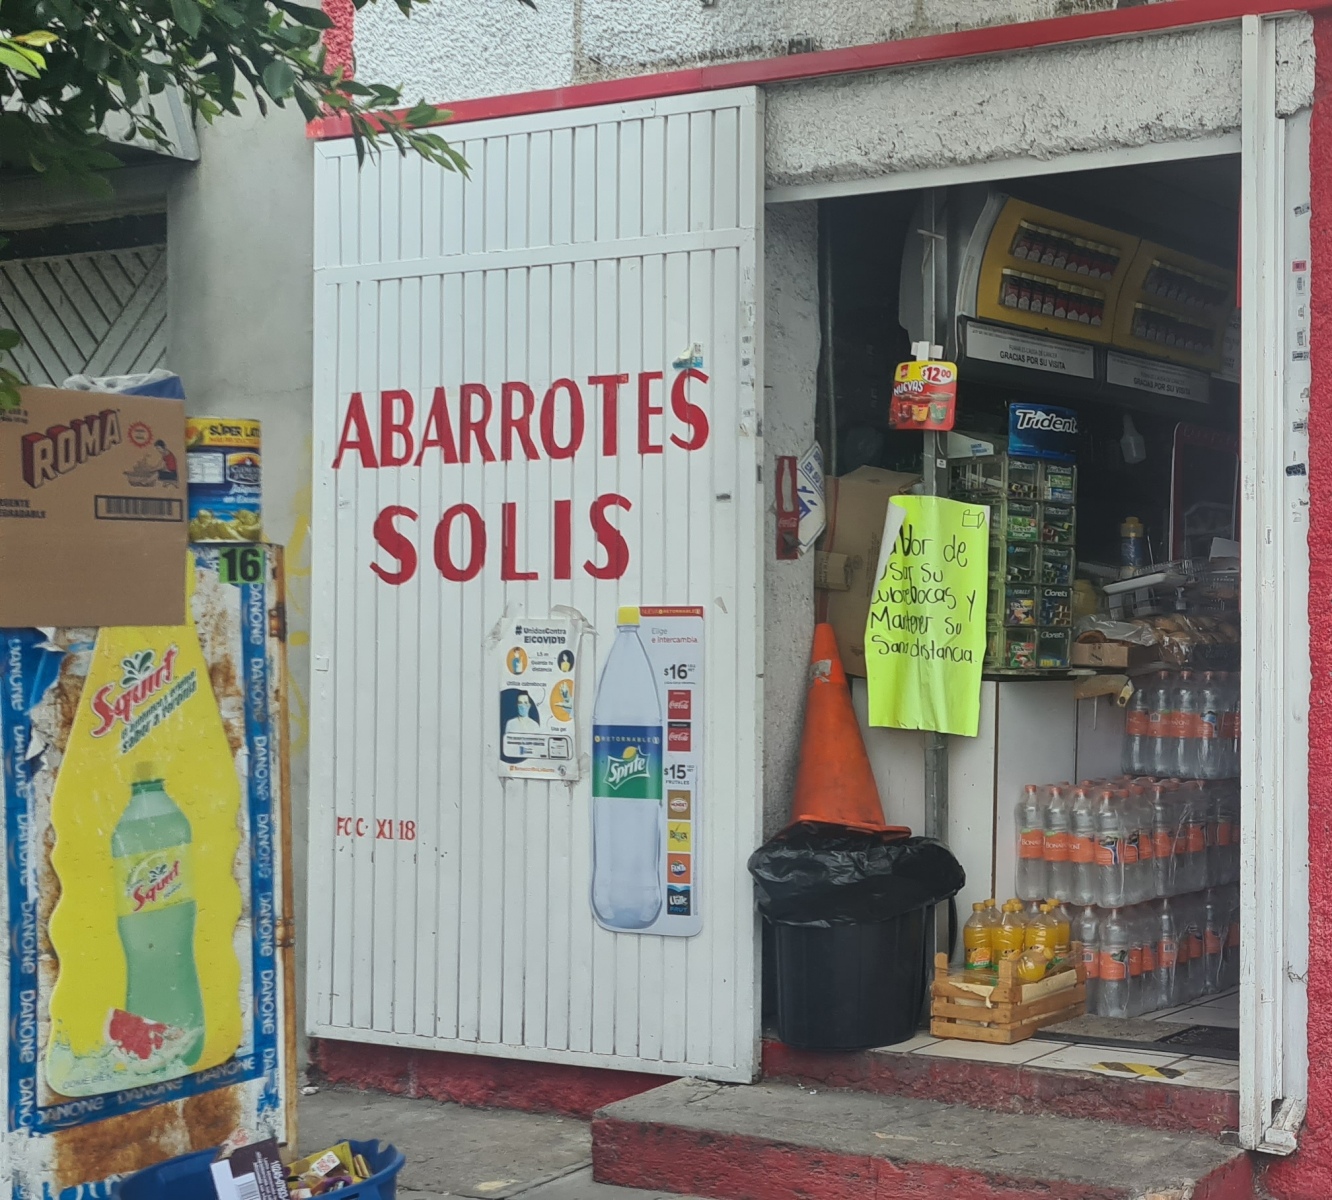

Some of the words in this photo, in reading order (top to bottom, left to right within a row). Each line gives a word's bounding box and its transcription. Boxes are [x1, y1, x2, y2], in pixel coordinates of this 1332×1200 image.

[1026, 355, 1038, 365] POR
[1039, 358, 1048, 366] SU
[331, 367, 710, 469] ABARROTES
[1016, 409, 1078, 434] Trident
[21, 408, 123, 489] ROMA
[369, 493, 632, 585] SOLIS
[222, 549, 261, 582] 16
[1044, 589, 1067, 597] Clorets
[664, 663, 688, 680] $16
[608, 754, 646, 784] Sprite
[664, 764, 687, 780] $15
[260, 970, 275, 1034] DANONE
[19, 990, 36, 1064] DANONE
